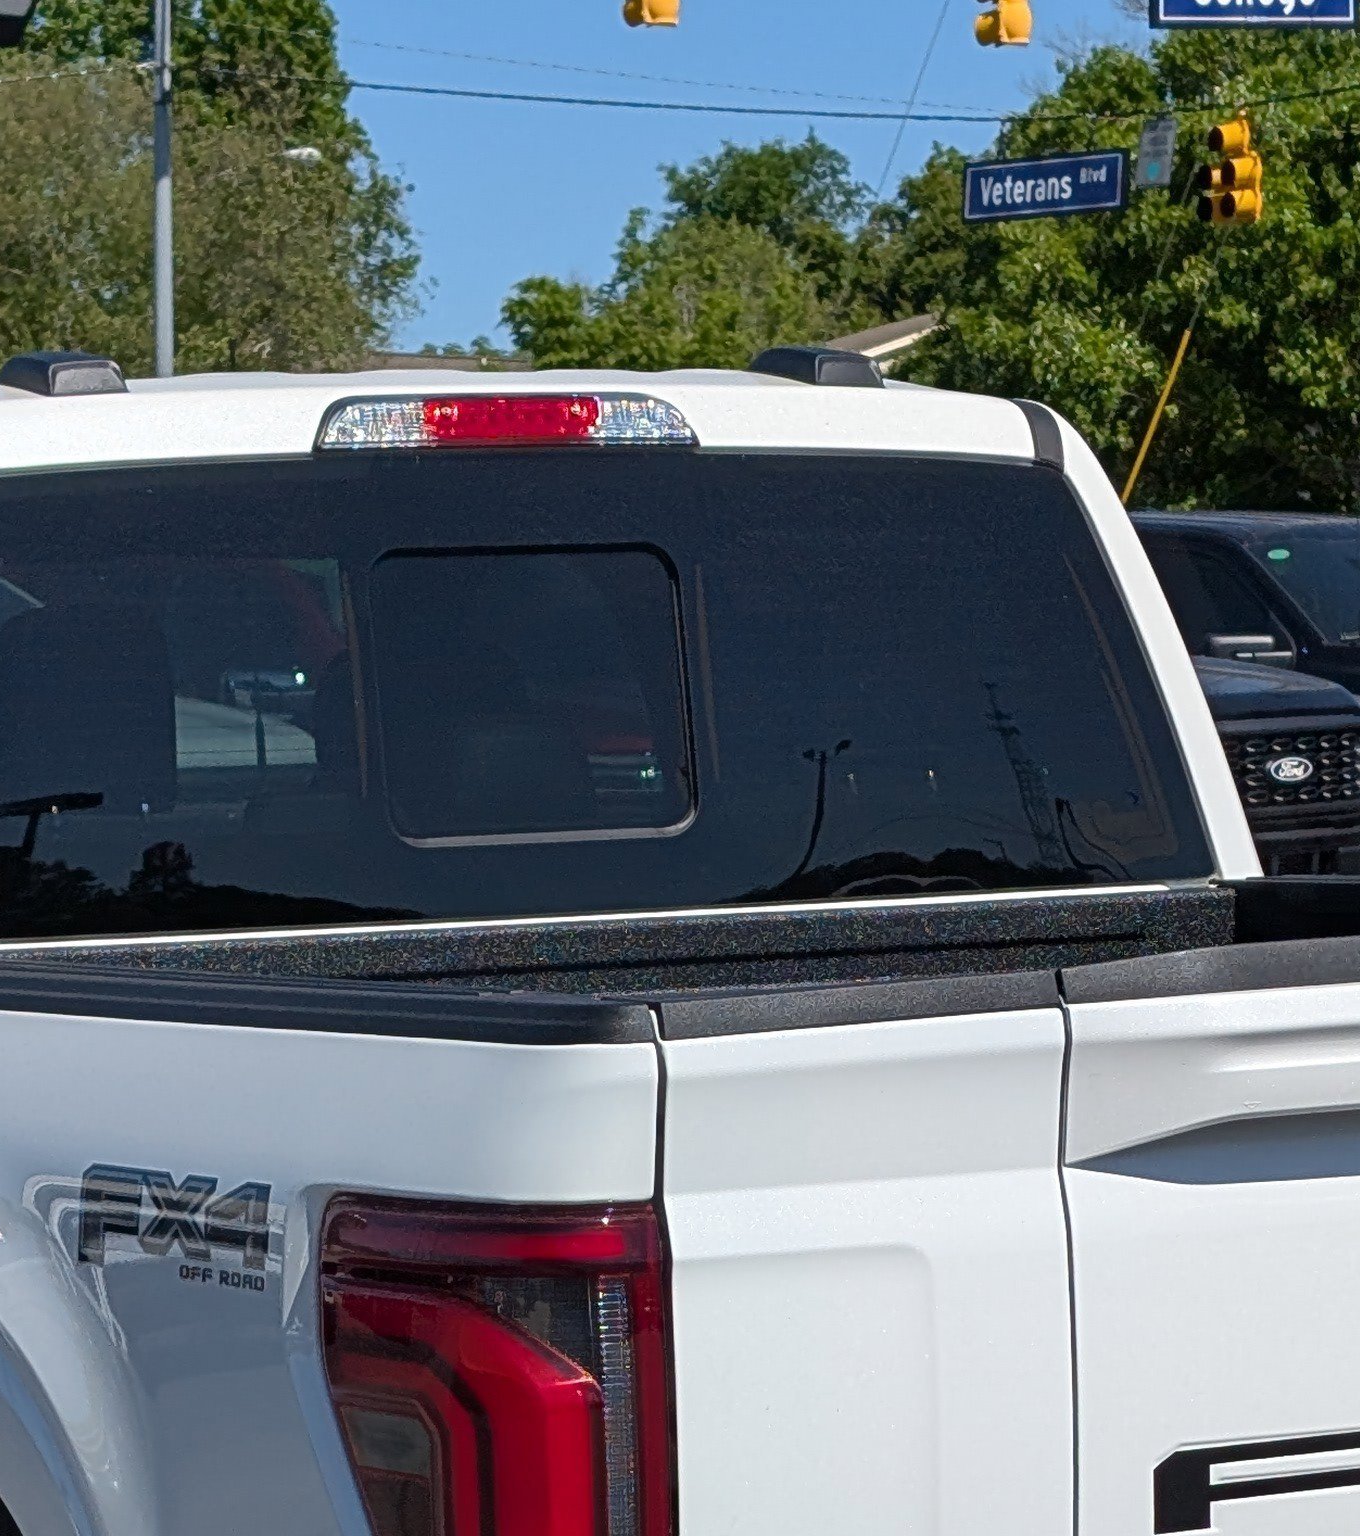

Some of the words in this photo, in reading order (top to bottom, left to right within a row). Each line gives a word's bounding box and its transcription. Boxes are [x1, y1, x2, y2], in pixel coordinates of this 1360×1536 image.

[980, 175, 1073, 207] Veterans
[1079, 164, 1107, 184] Blvd
[78, 1162, 272, 1271] FX4
[179, 1264, 213, 1283] OFF
[218, 1268, 265, 1292] ROAD
